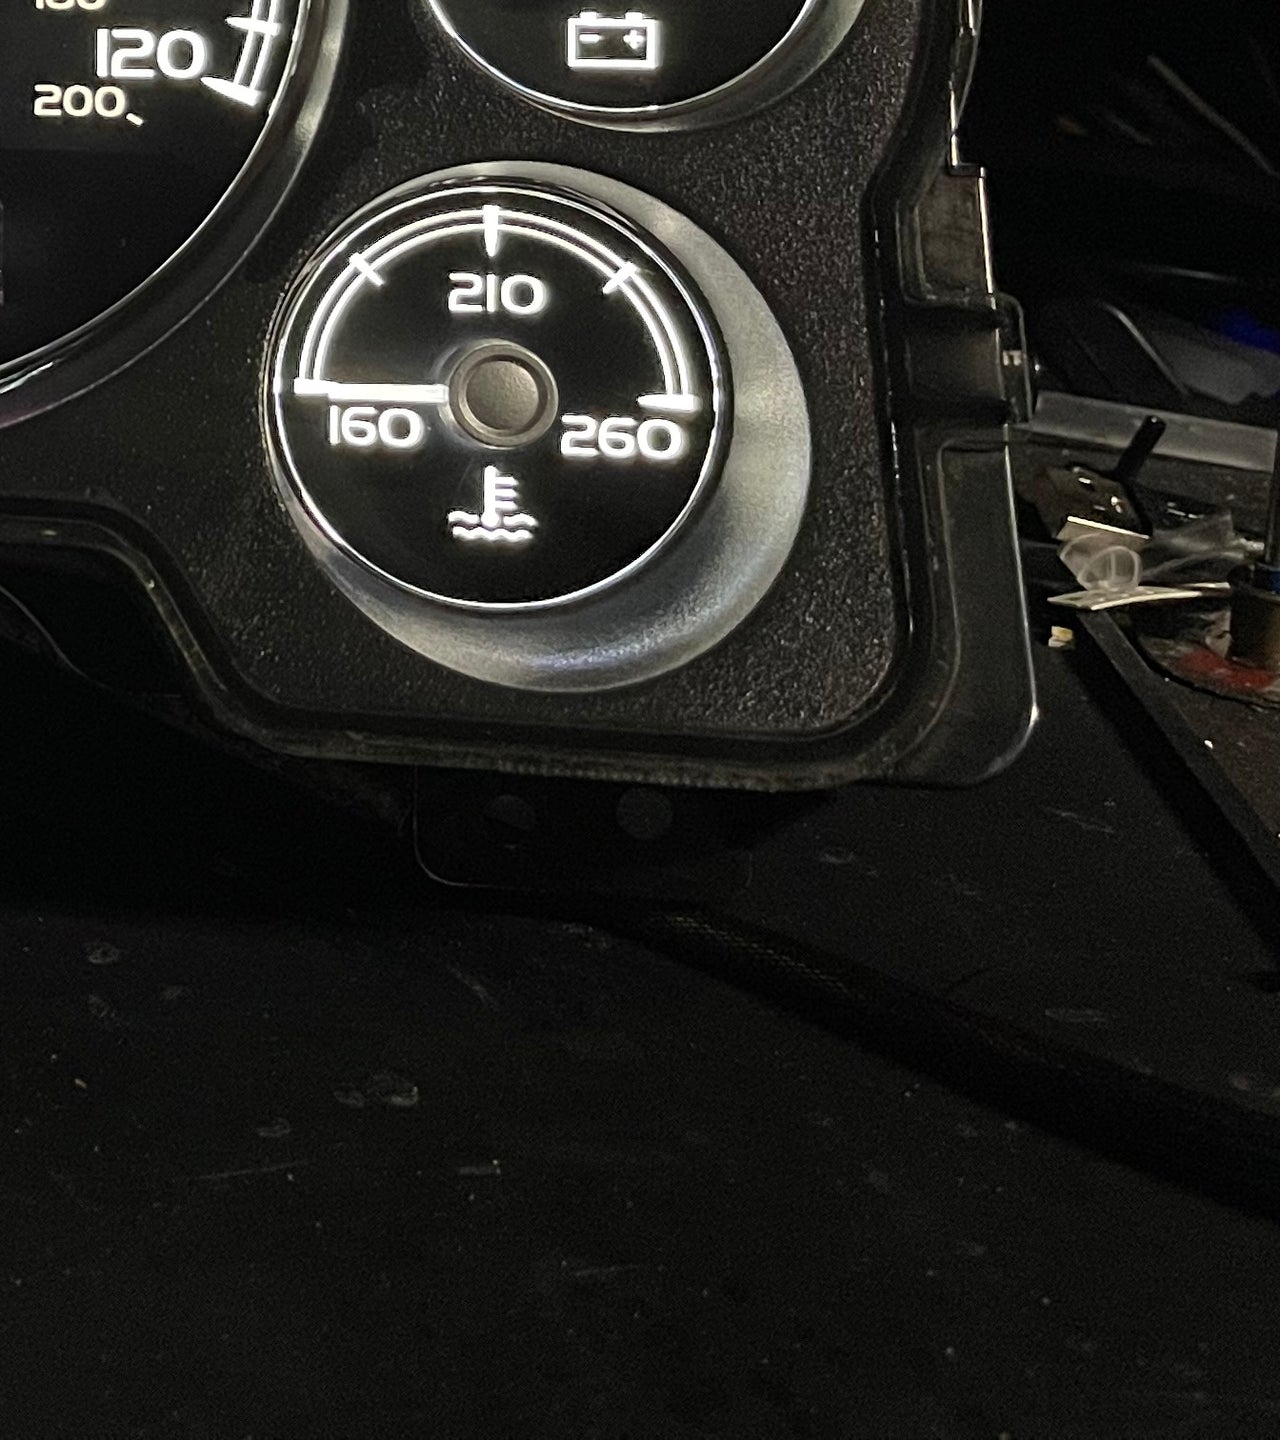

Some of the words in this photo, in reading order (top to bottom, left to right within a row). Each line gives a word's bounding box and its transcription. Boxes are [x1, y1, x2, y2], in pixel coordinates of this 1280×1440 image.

[97, 29, 205, 78] 120
[35, 85, 125, 116] 200
[449, 273, 547, 314] 210
[330, 406, 422, 447] 160
[561, 416, 681, 459] 260
